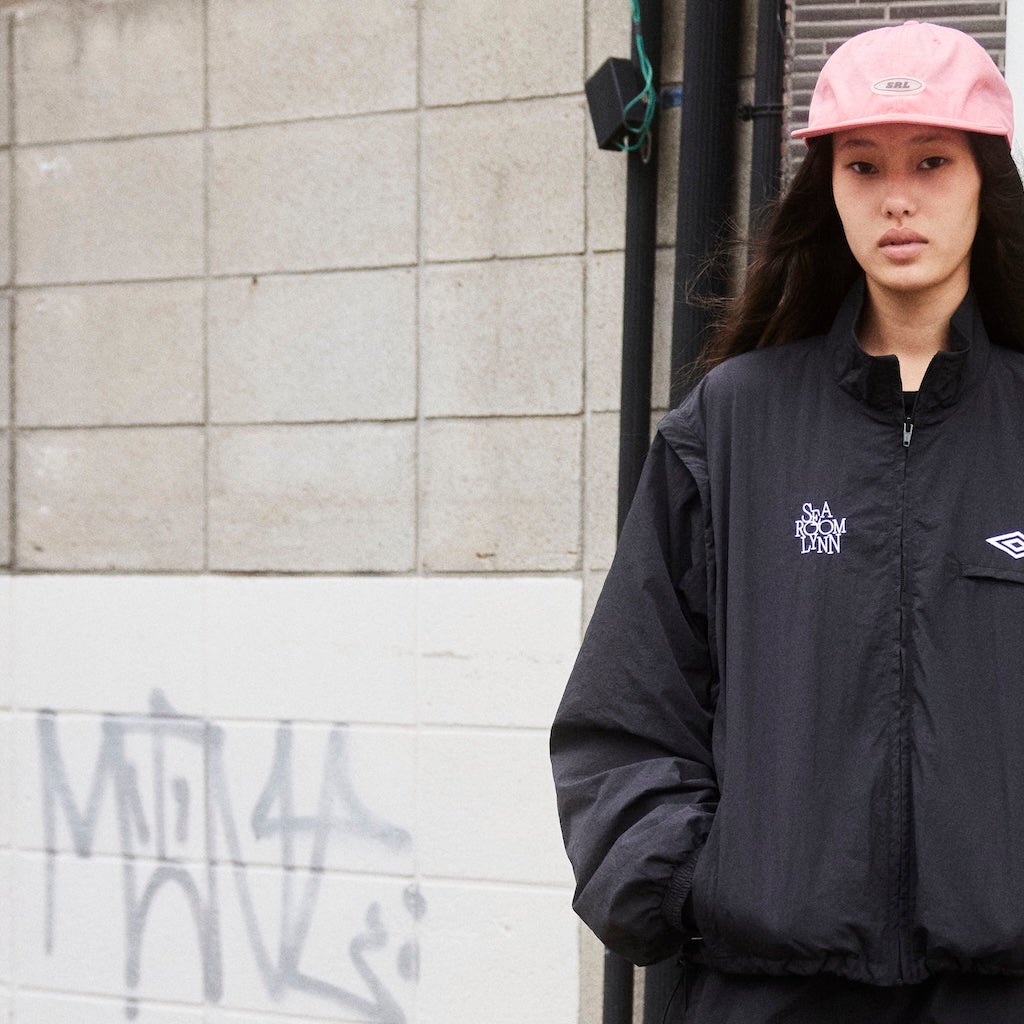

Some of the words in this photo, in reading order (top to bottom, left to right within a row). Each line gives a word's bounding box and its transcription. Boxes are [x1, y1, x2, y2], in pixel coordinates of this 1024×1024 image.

[886, 81, 910, 89] SRL
[801, 501, 833, 526] SEA
[795, 518, 847, 538] ROOM
[800, 533, 842, 555] LYNN
